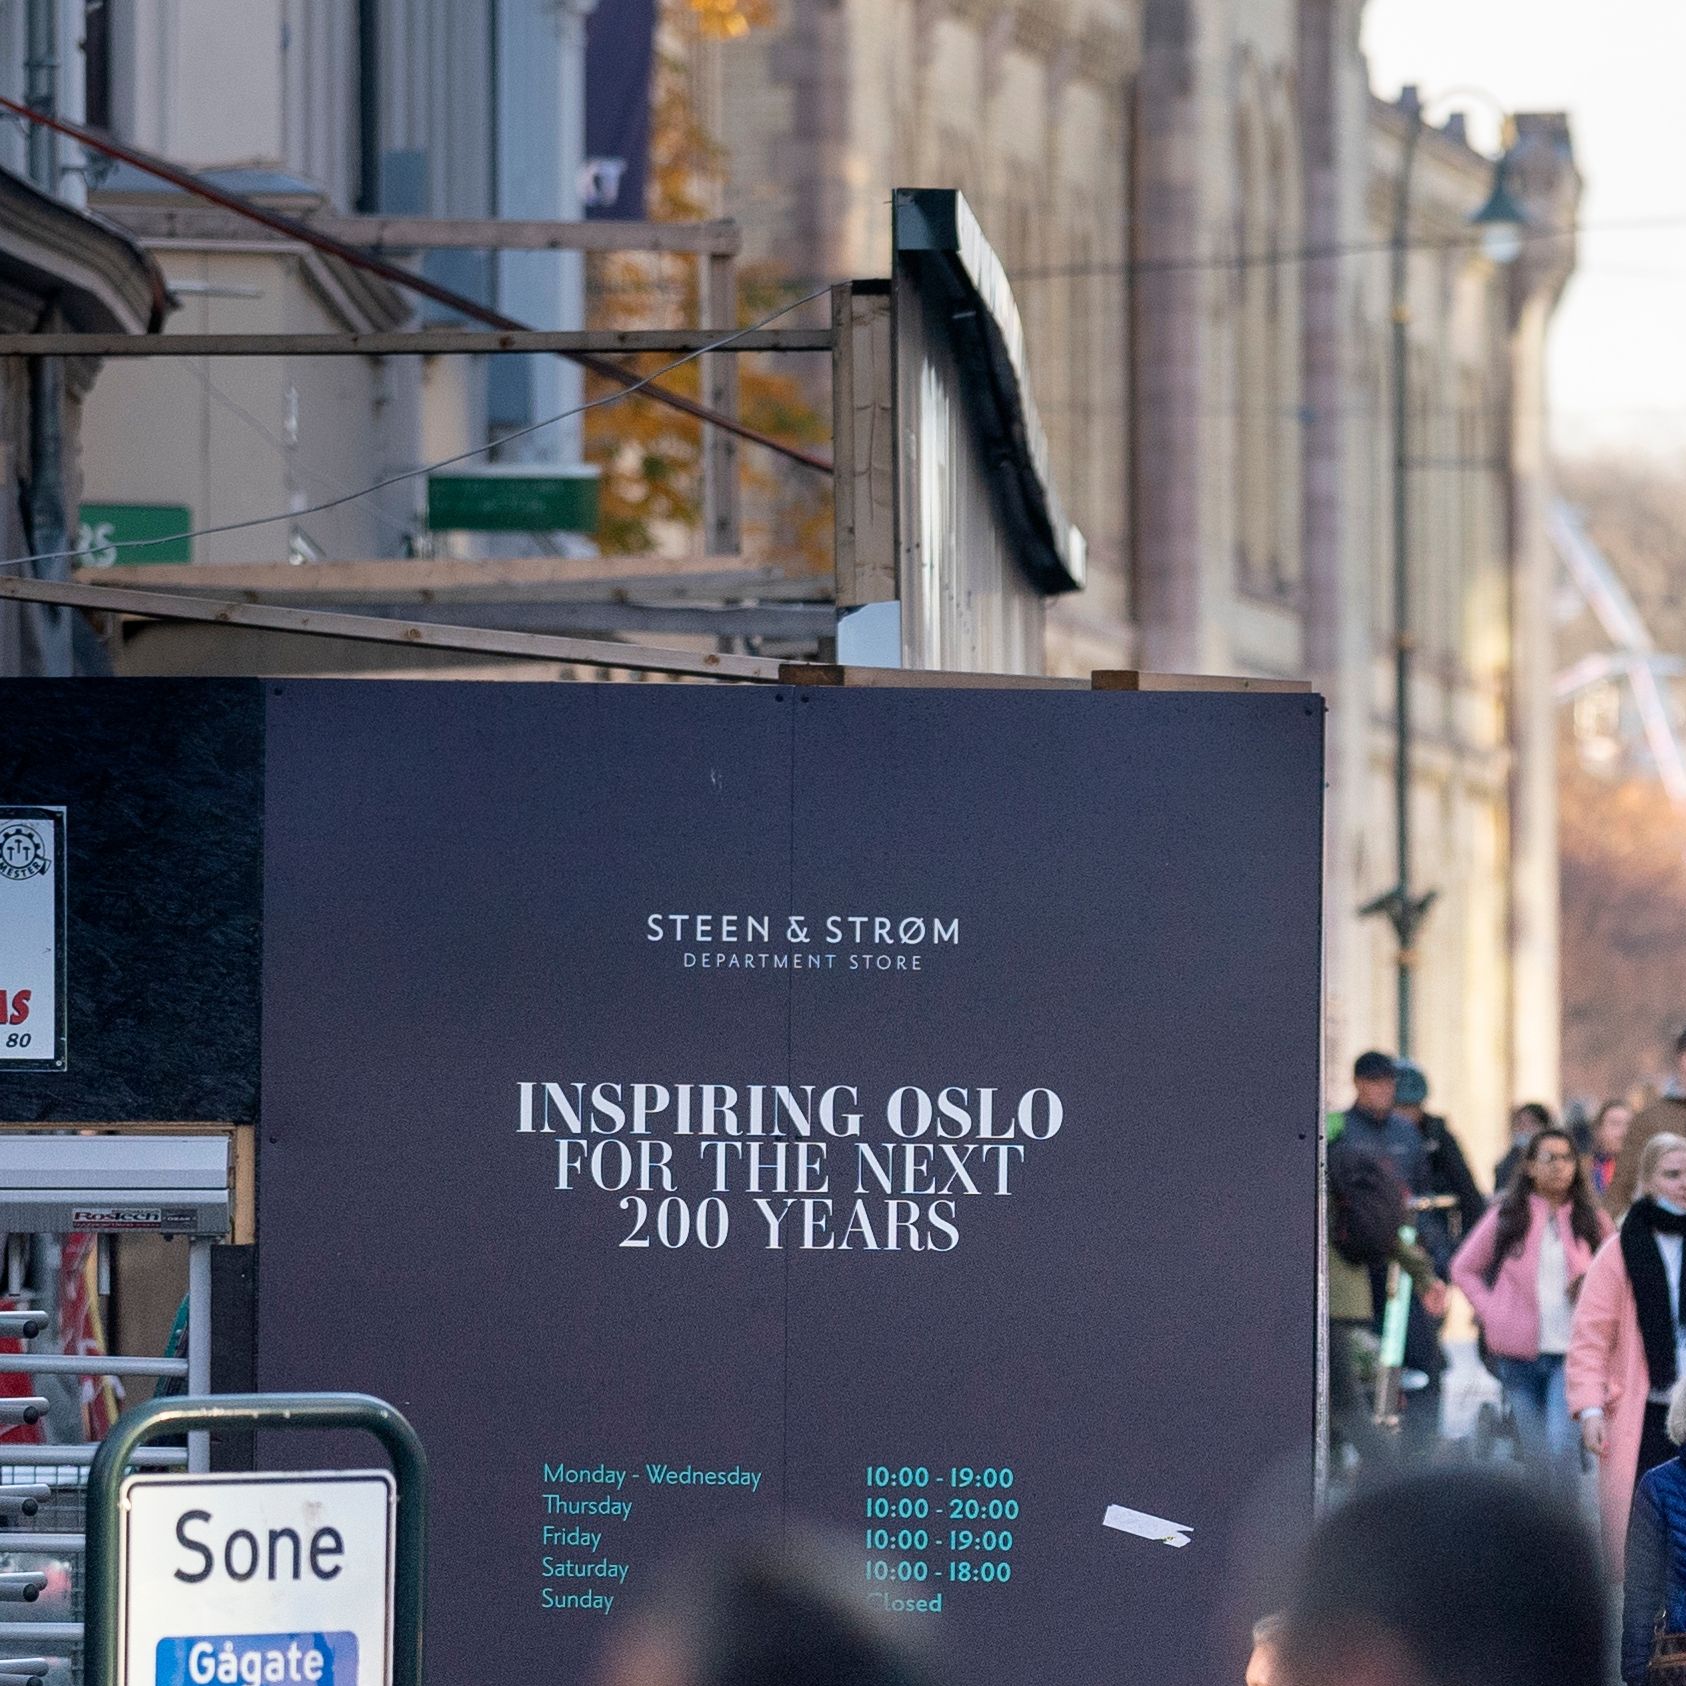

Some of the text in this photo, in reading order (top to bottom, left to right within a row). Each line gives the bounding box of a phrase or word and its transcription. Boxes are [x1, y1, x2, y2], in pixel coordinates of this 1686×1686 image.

[647, 913, 960, 945] STEEN & STRØM
[683, 952, 922, 971] DEPARTMENT STORE
[6, 1033, 32, 1048] 80
[516, 1081, 1064, 1140] INSPIRING OSLO
[555, 1138, 1025, 1196] FOR THE NEXT
[618, 1196, 960, 1252] 200 YEARS
[542, 1463, 626, 1489] Monday
[645, 1464, 762, 1492] Wednesday
[865, 1466, 930, 1488] 10:00
[950, 1467, 1015, 1489] 19:00
[542, 1493, 633, 1521] Thursday
[865, 1497, 930, 1519] 10:00
[949, 1498, 1020, 1520] 20:00
[173, 1508, 346, 1585] Sone
[542, 1525, 602, 1552] Friday
[865, 1529, 930, 1551] 10:00
[950, 1530, 1014, 1552] 19:00
[541, 1556, 629, 1583] Saturday
[865, 1560, 929, 1582] 10:00
[949, 1561, 1012, 1583] 18:00
[541, 1588, 614, 1615] Sunday
